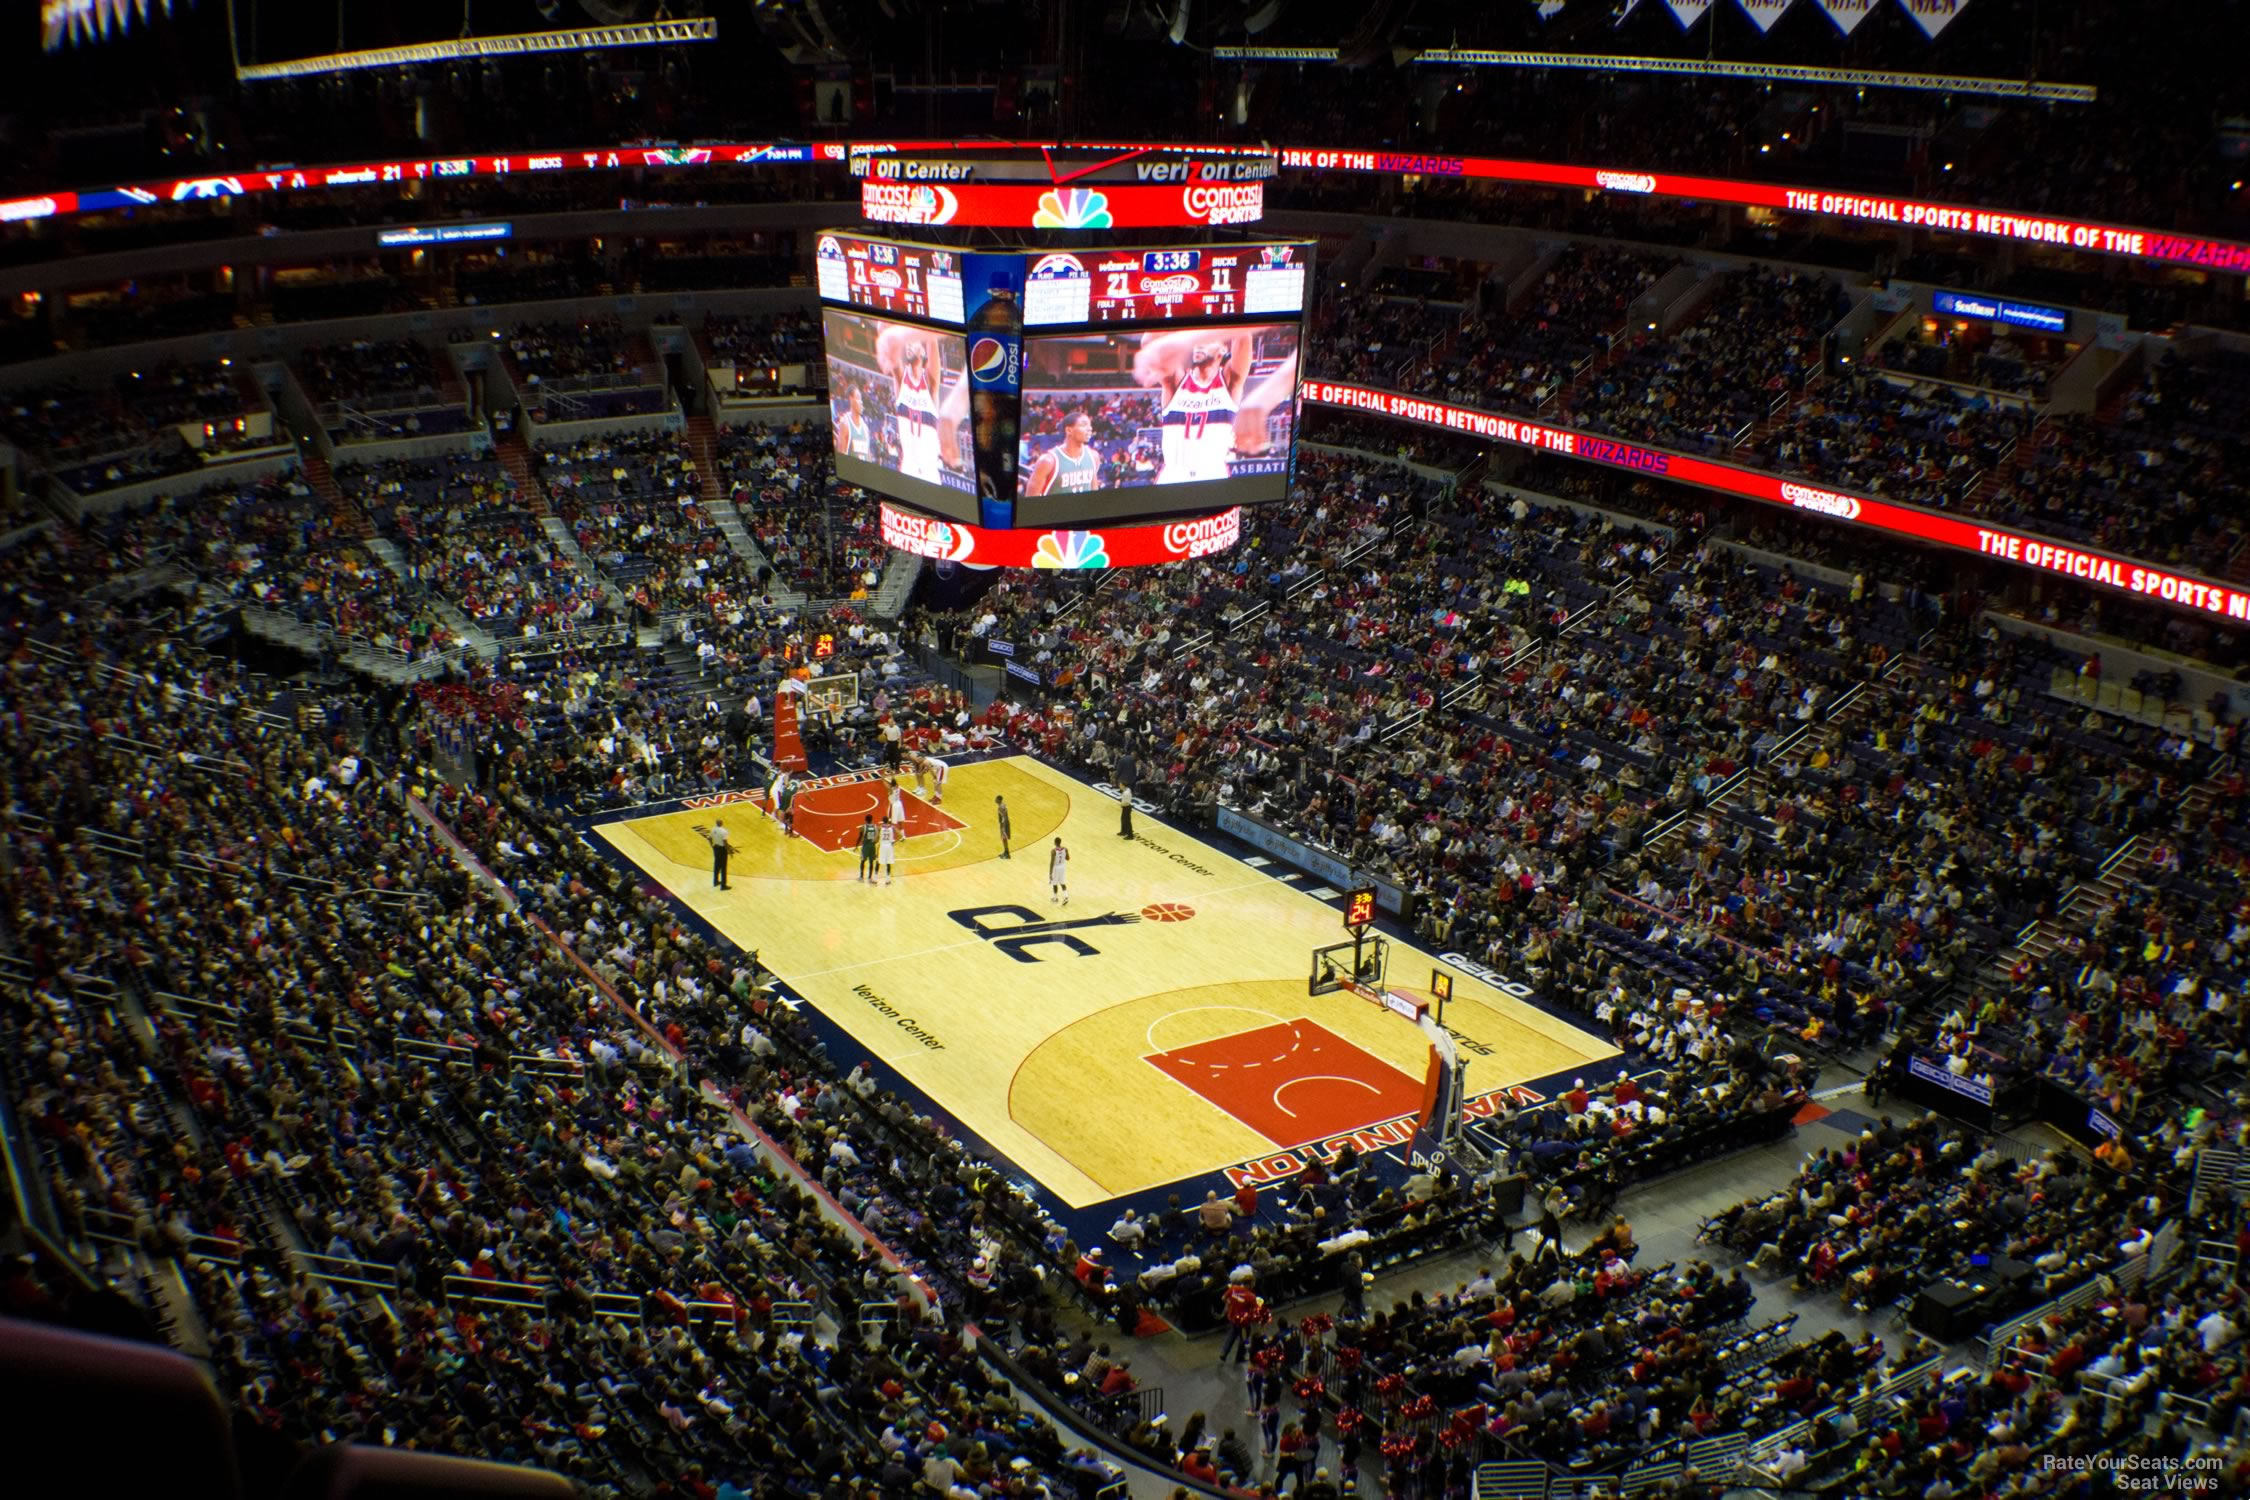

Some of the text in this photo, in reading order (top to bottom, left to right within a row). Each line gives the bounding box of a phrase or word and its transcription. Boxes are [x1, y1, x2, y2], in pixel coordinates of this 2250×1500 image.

[905, 163, 971, 180] Center
[1137, 157, 1272, 182] verizon Center
[1317, 152, 1338, 169] OF
[1343, 153, 1374, 170] THE
[1378, 155, 1463, 175] WIZARDS
[1786, 191, 1818, 212] THE
[1822, 194, 1899, 221] OFFICIAL
[1903, 205, 1973, 231] SPORTS
[1977, 214, 2069, 244] NETWORK
[2074, 226, 2100, 247] OF
[2104, 230, 2143, 254] THE
[1153, 252, 1190, 270] 3:36
[1212, 256, 1237, 267] BUCKS
[1107, 273, 1131, 297] 21
[1211, 268, 1231, 292] 11
[1008, 342, 1019, 384] pepsi
[1184, 411, 1209, 440] 17
[1322, 385, 1388, 412] OFFICIAL
[1390, 397, 1443, 424] SPORTS
[1446, 407, 1517, 441] NETWORK
[1520, 423, 1541, 446] OF
[1543, 429, 1574, 453] THE
[1577, 436, 1669, 473] WIZARDS
[1231, 461, 1286, 475] ASERATI
[1978, 530, 2020, 560] THE
[2024, 543, 2125, 587] OFFICIAL
[2131, 569, 2223, 612] SPORTS
[815, 642, 833, 656] 24
[1169, 854, 1216, 876] Center
[1351, 903, 1370, 921] 24
[1439, 952, 1534, 996] GEICO
[852, 983, 946, 1052] Verizon Center
[1913, 1061, 1992, 1100] GEICO GEICO
